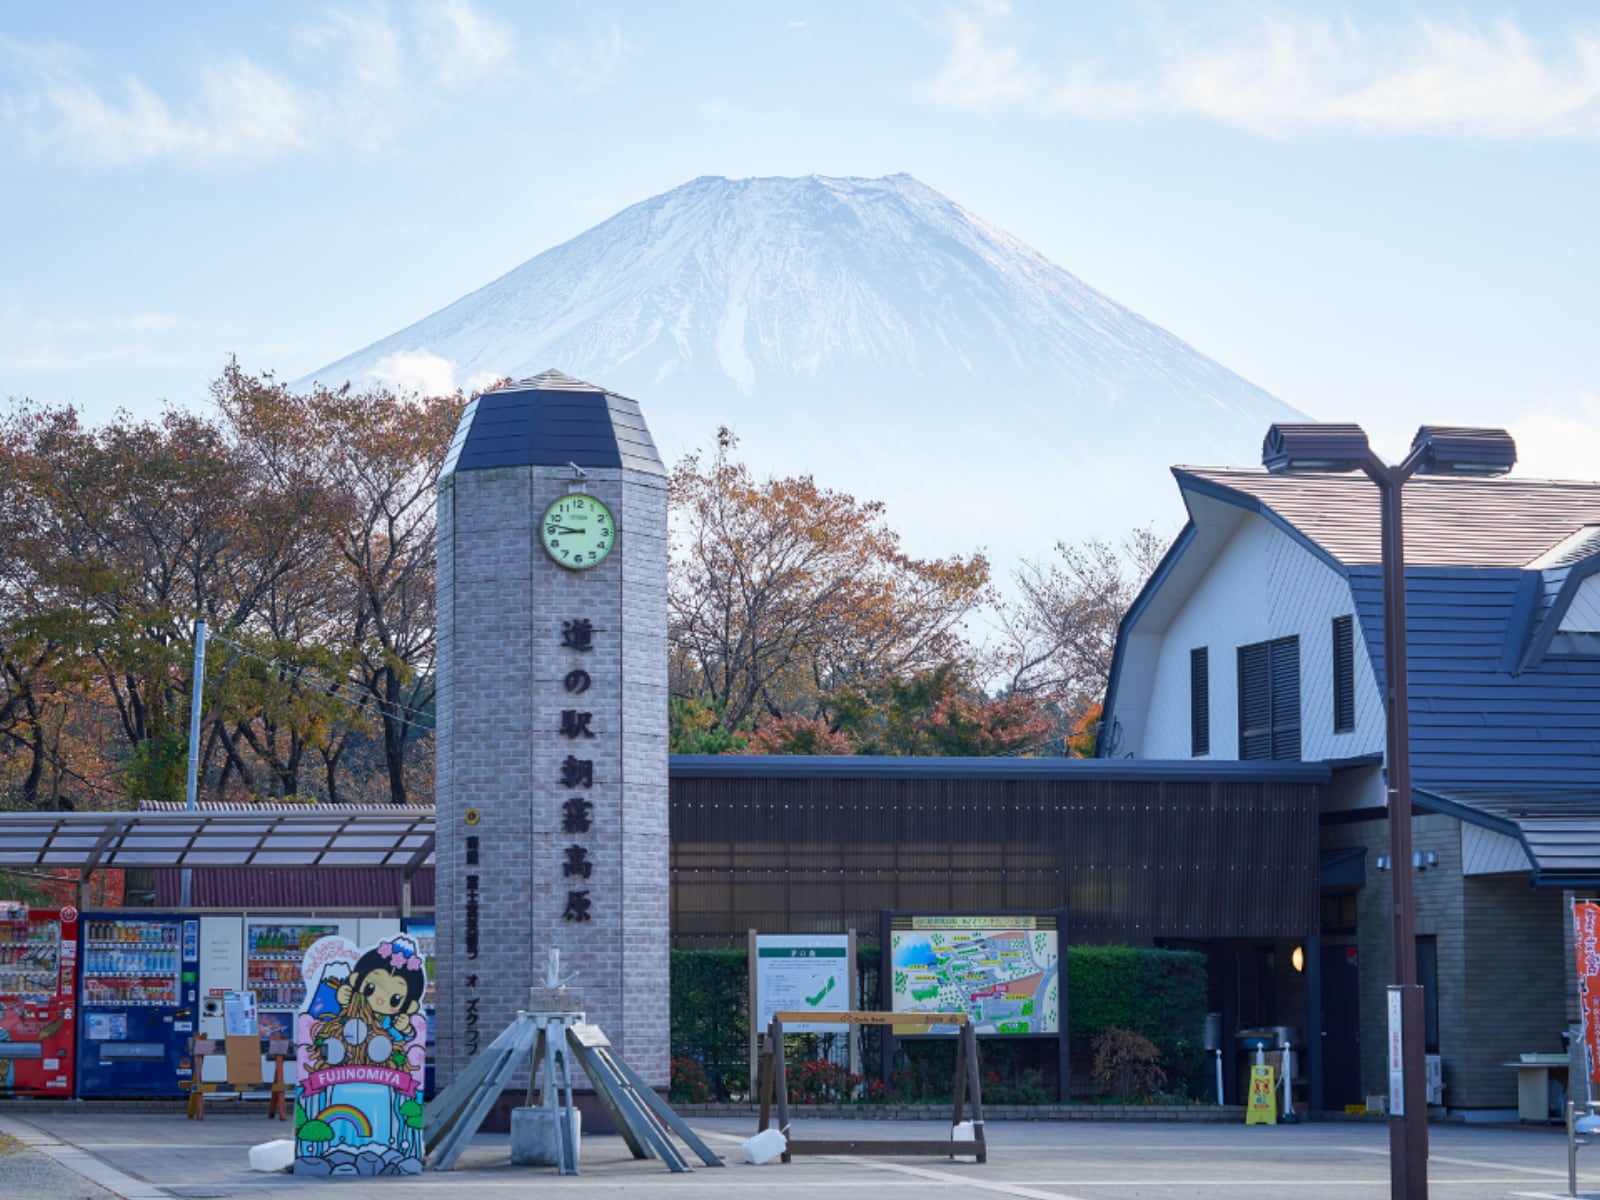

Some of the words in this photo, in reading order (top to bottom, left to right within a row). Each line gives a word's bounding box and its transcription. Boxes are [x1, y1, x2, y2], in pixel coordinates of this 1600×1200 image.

[559, 504, 570, 512] 11
[573, 499, 584, 509] 12
[551, 514, 562, 523] 10
[597, 514, 604, 523] 2
[601, 528, 609, 536] 3
[551, 539, 559, 548] 8
[597, 541, 605, 549] 4
[561, 550, 569, 558] 7
[560, 618, 595, 922] 道の駅朝霧高原
[318, 1068, 401, 1085] FUJINOMIYA
